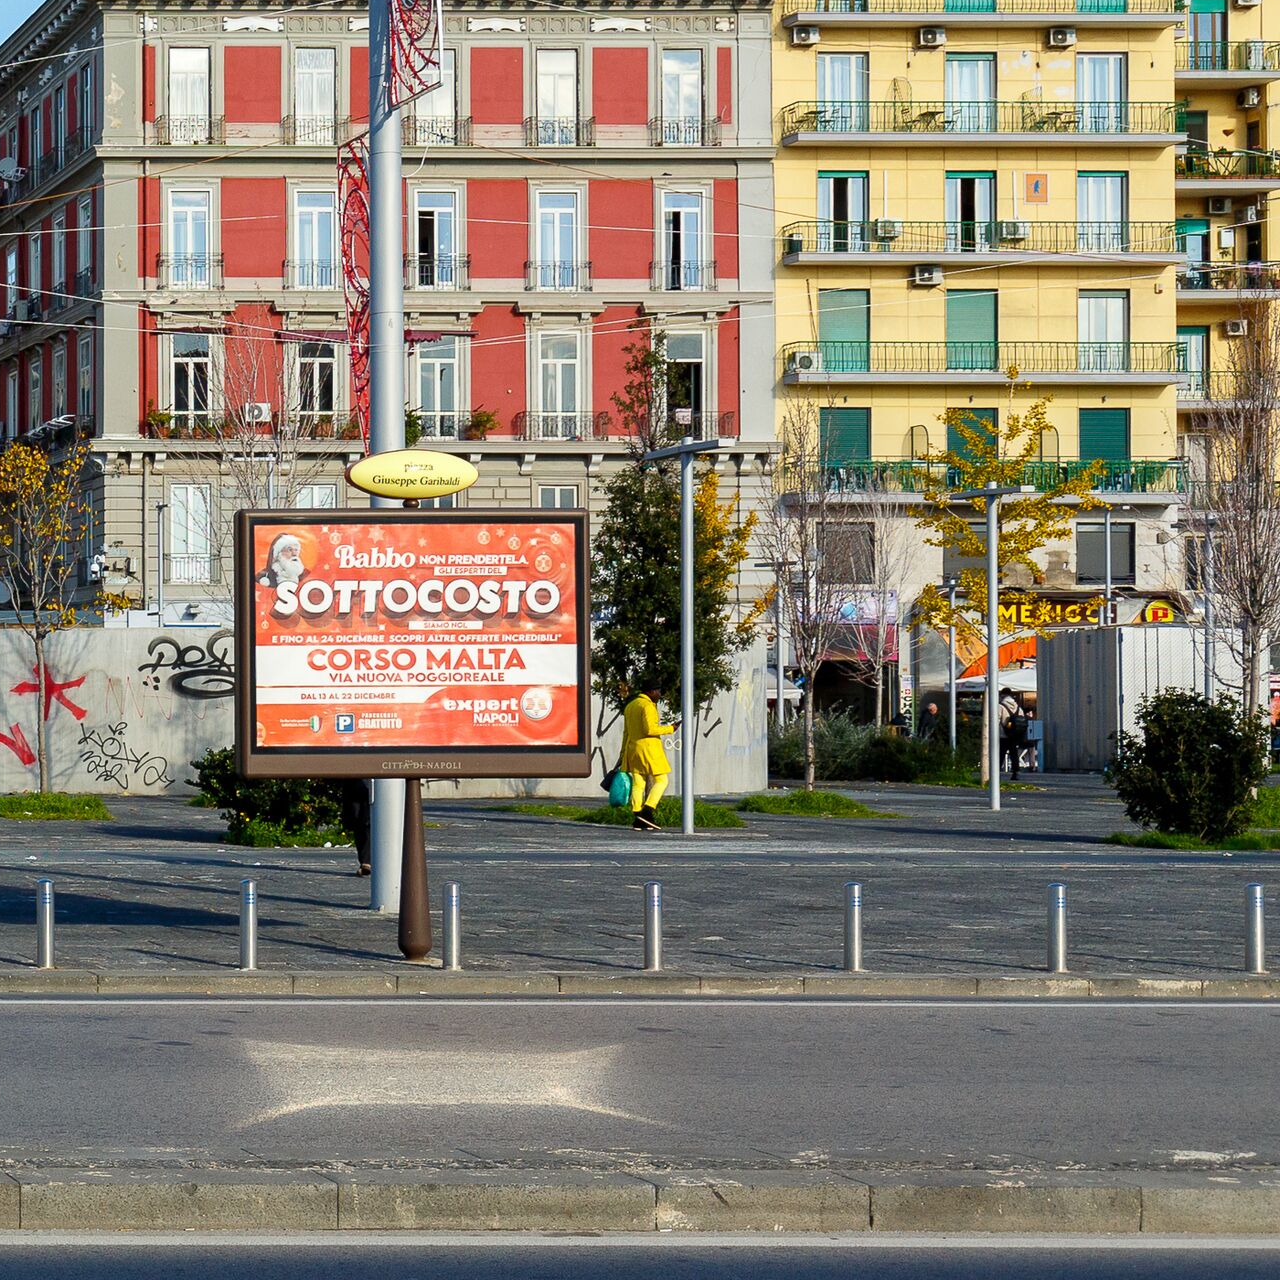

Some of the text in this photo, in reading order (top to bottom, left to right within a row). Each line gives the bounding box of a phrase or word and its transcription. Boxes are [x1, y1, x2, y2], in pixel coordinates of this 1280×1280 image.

[404, 462, 434, 473] piazza
[372, 475, 461, 488] Giuseppe Garibaldi
[334, 544, 416, 569] Babbo
[419, 554, 446, 565] NON
[438, 567, 502, 575] GLI ESPERTI DEL
[273, 579, 561, 616] SOTTOCOSTO
[998, 604, 1099, 623] MEXICO
[272, 635, 278, 643] E
[280, 635, 304, 643] FINO
[306, 635, 319, 643] AL
[321, 635, 334, 643] 24
[335, 634, 385, 643] DICEMBRE
[389, 634, 425, 643] SCOPRI
[427, 634, 456, 642] ALTRE
[457, 634, 500, 642] OFFERTE
[306, 648, 527, 671] CORSO MALTA
[329, 672, 505, 683] VIA NUOVA POGGIOREALE
[354, 692, 396, 700] DICEMBRE
[443, 697, 519, 713] expert
[358, 718, 402, 729] GRATUITO
[473, 713, 519, 724] NAPOLI
[427, 761, 462, 770] NAPOLI
